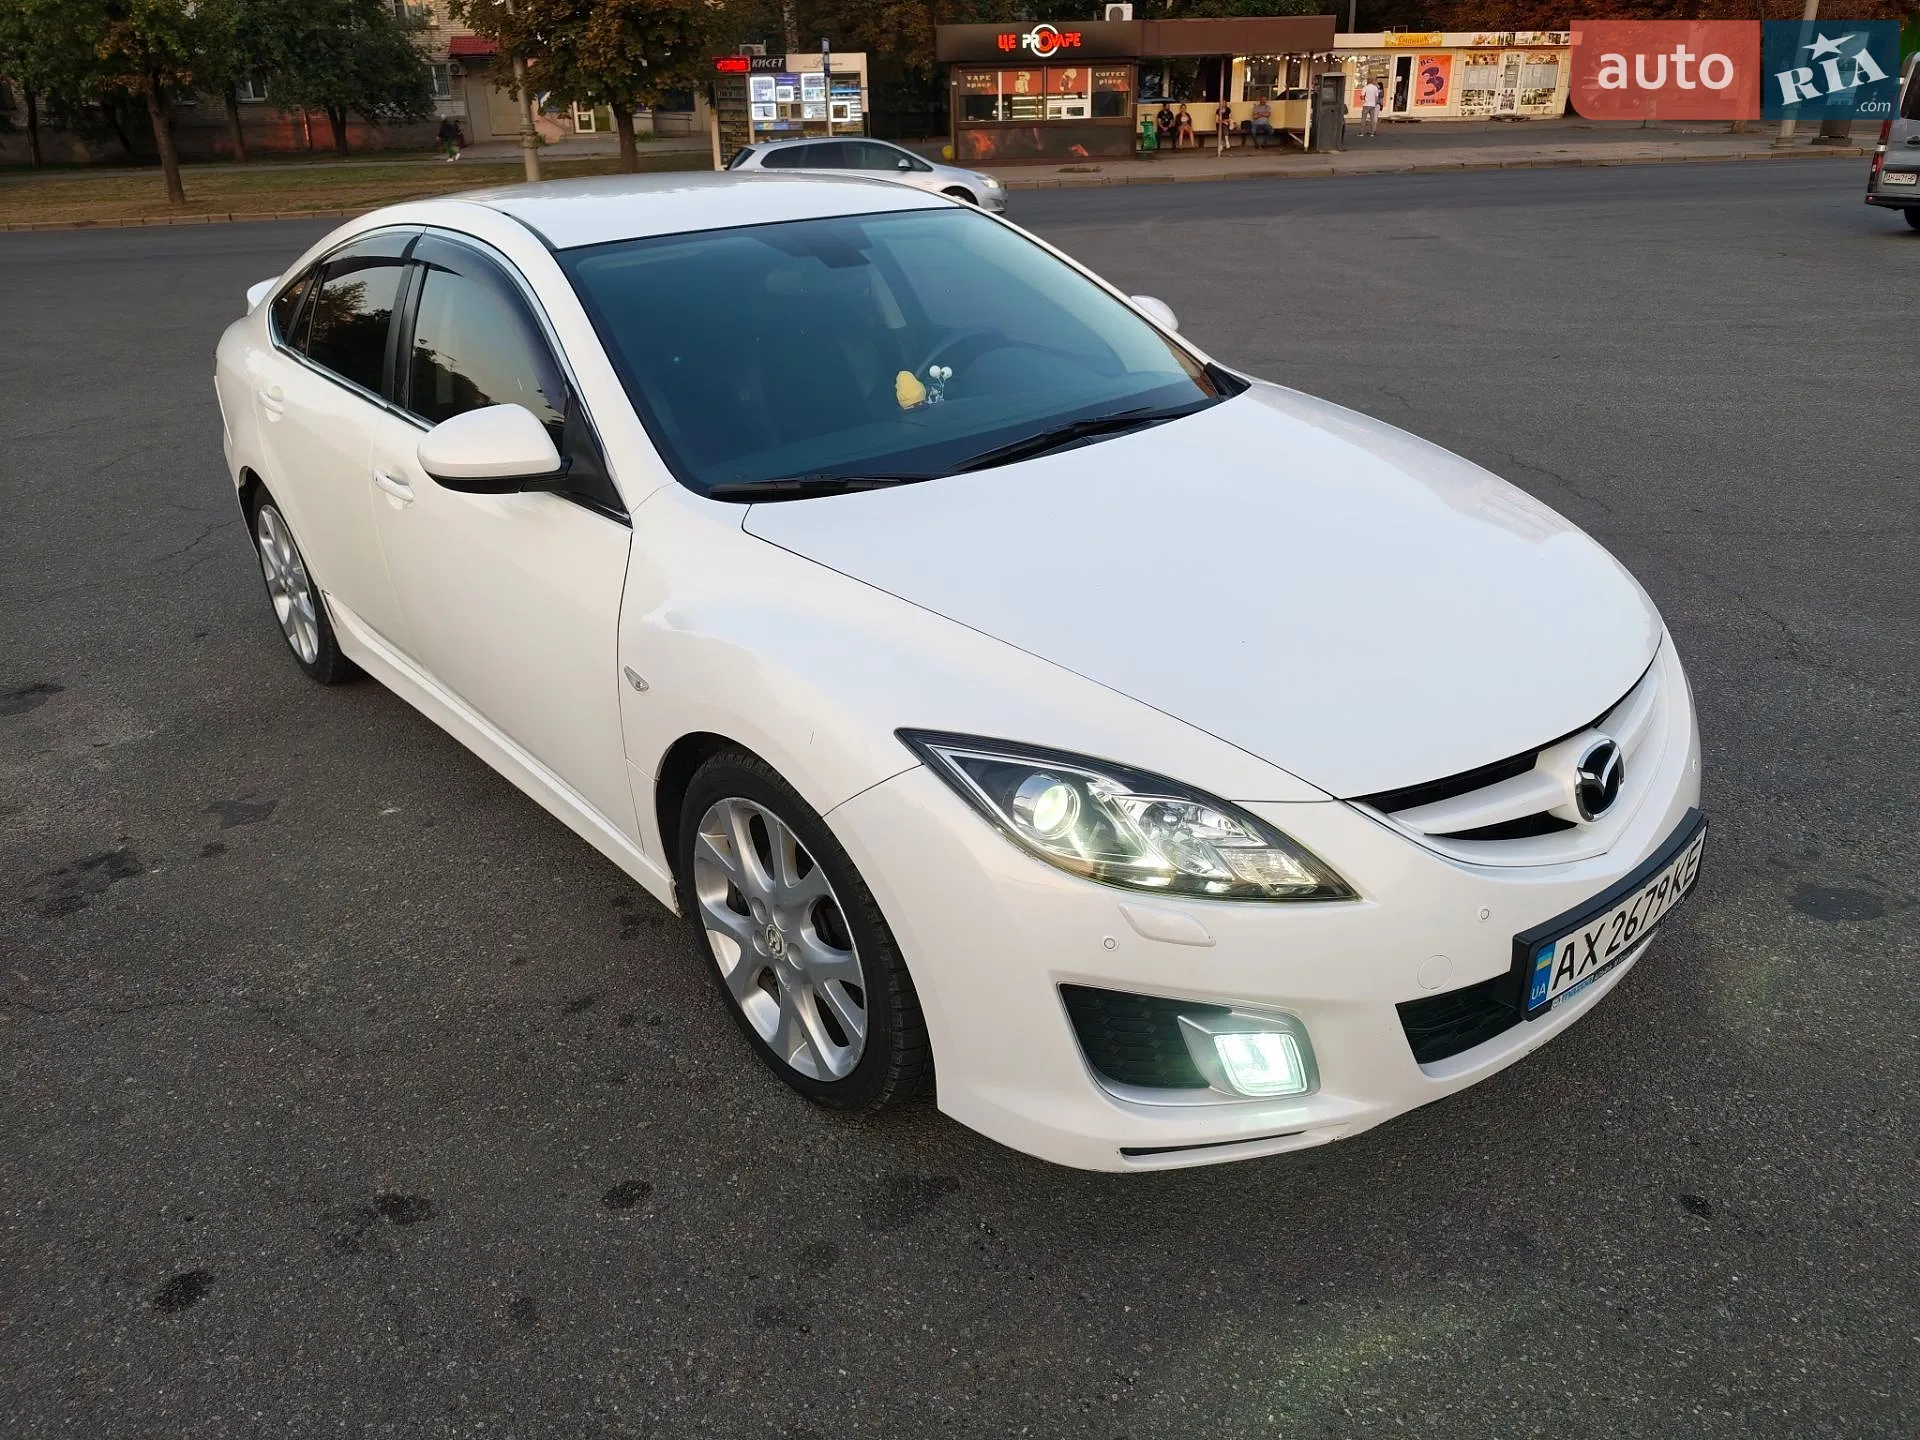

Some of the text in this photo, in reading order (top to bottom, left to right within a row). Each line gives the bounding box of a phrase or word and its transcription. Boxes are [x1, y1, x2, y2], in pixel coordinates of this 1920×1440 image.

[998, 34, 1016, 51] ЦЕ
[752, 58, 784, 68] КИСЕТ
[1421, 66, 1445, 96] 3
[1552, 922, 1606, 991] AX
[1605, 875, 1670, 957] 2679
[1668, 837, 1702, 904] KE
[1531, 983, 1546, 1001] UA
